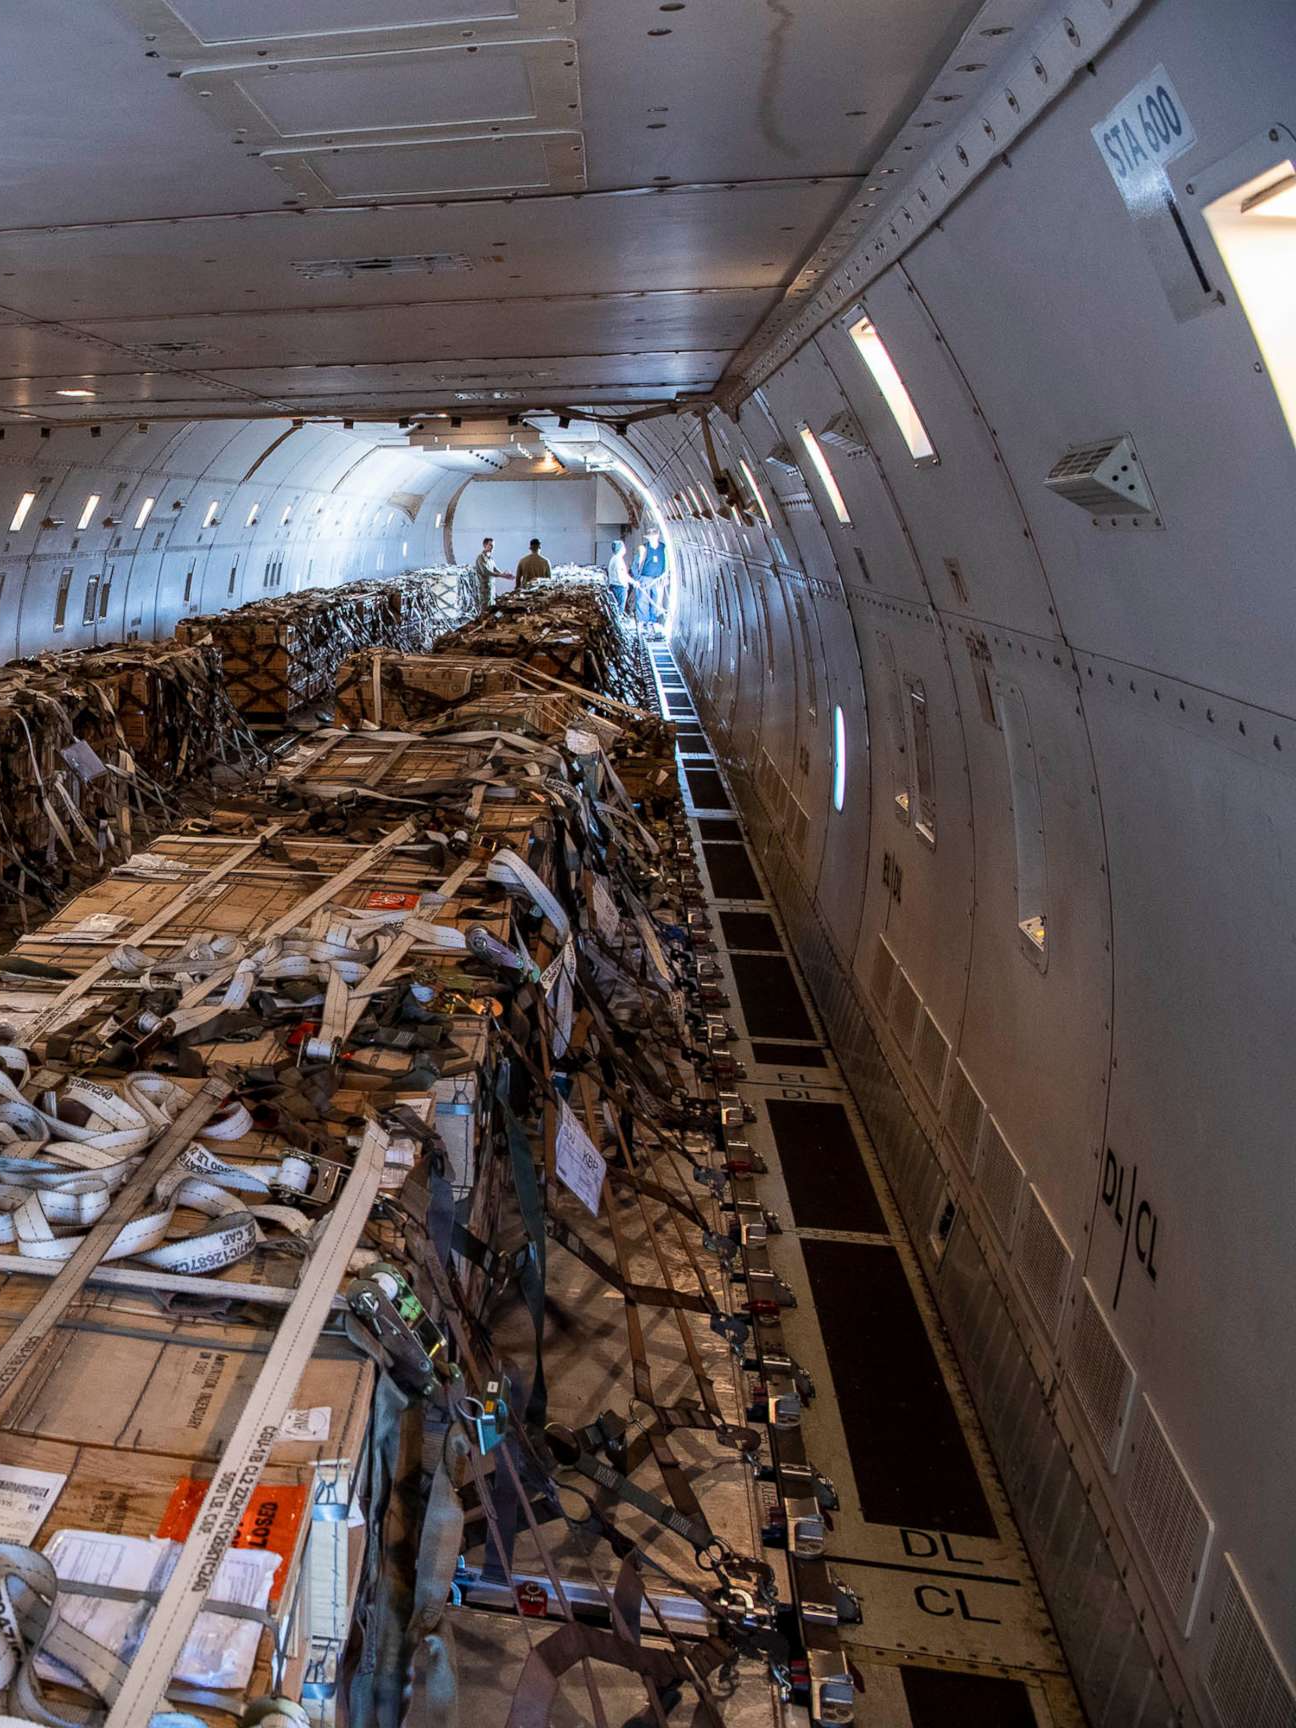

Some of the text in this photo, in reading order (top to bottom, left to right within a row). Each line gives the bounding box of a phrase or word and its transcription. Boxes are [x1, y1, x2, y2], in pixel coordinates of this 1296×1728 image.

[1103, 85, 1182, 178] STA 600
[778, 1073, 820, 1084] EL
[249, 1500, 278, 1547] LOSED
[900, 1528, 983, 1565] DL
[914, 1585, 1001, 1624] CL
